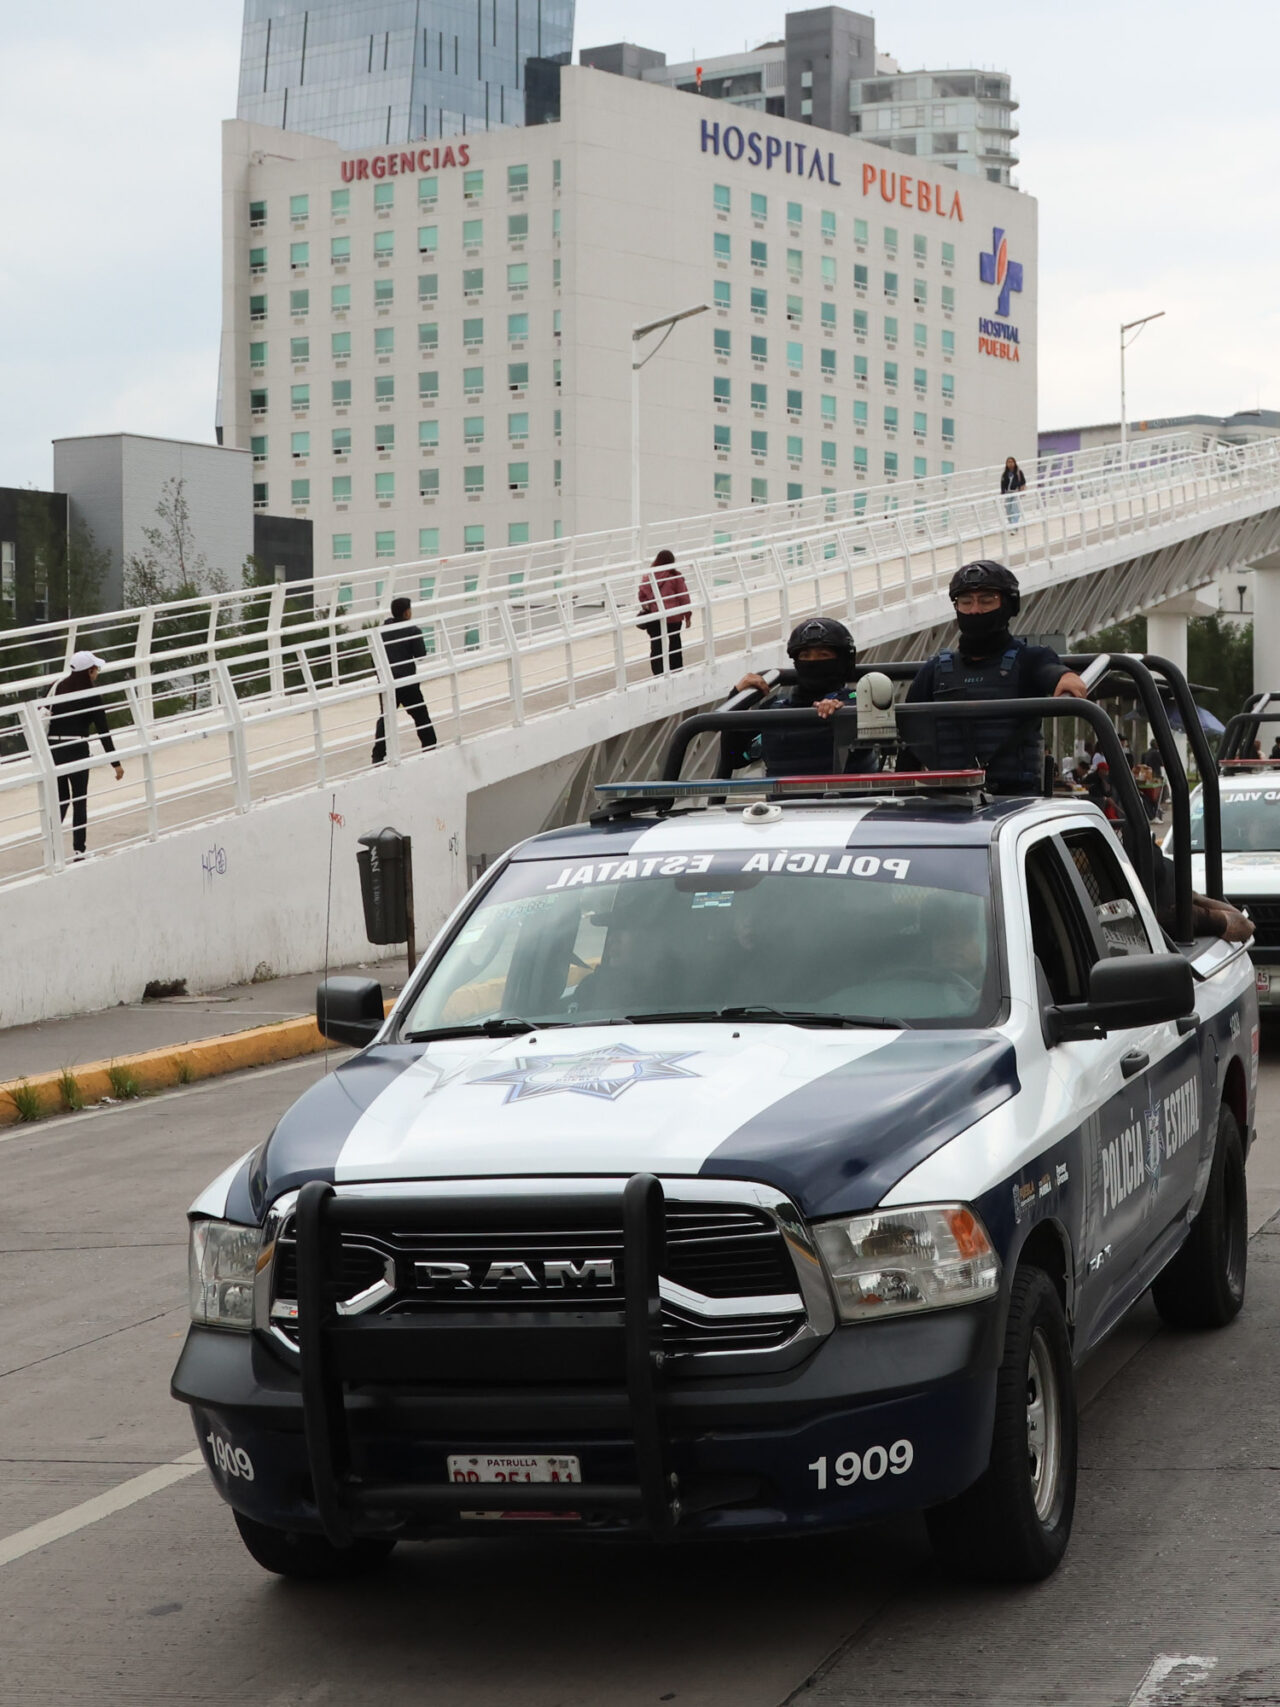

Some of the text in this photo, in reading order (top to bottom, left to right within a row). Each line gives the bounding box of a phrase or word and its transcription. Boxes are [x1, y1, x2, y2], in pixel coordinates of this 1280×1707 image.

[340, 143, 471, 183] URGENCIAS
[700, 118, 965, 223] HOSPITAL PUEBLA
[978, 317, 1021, 345] HOSPITAL
[978, 336, 1021, 363] PUEBLA
[1101, 1075, 1200, 1218] POLICÍA ESTATAL
[413, 1258, 617, 1290] RAM
[206, 1431, 255, 1482] 1909
[486, 1458, 538, 1467] PATRULLA
[807, 1438, 915, 1491] 1909
